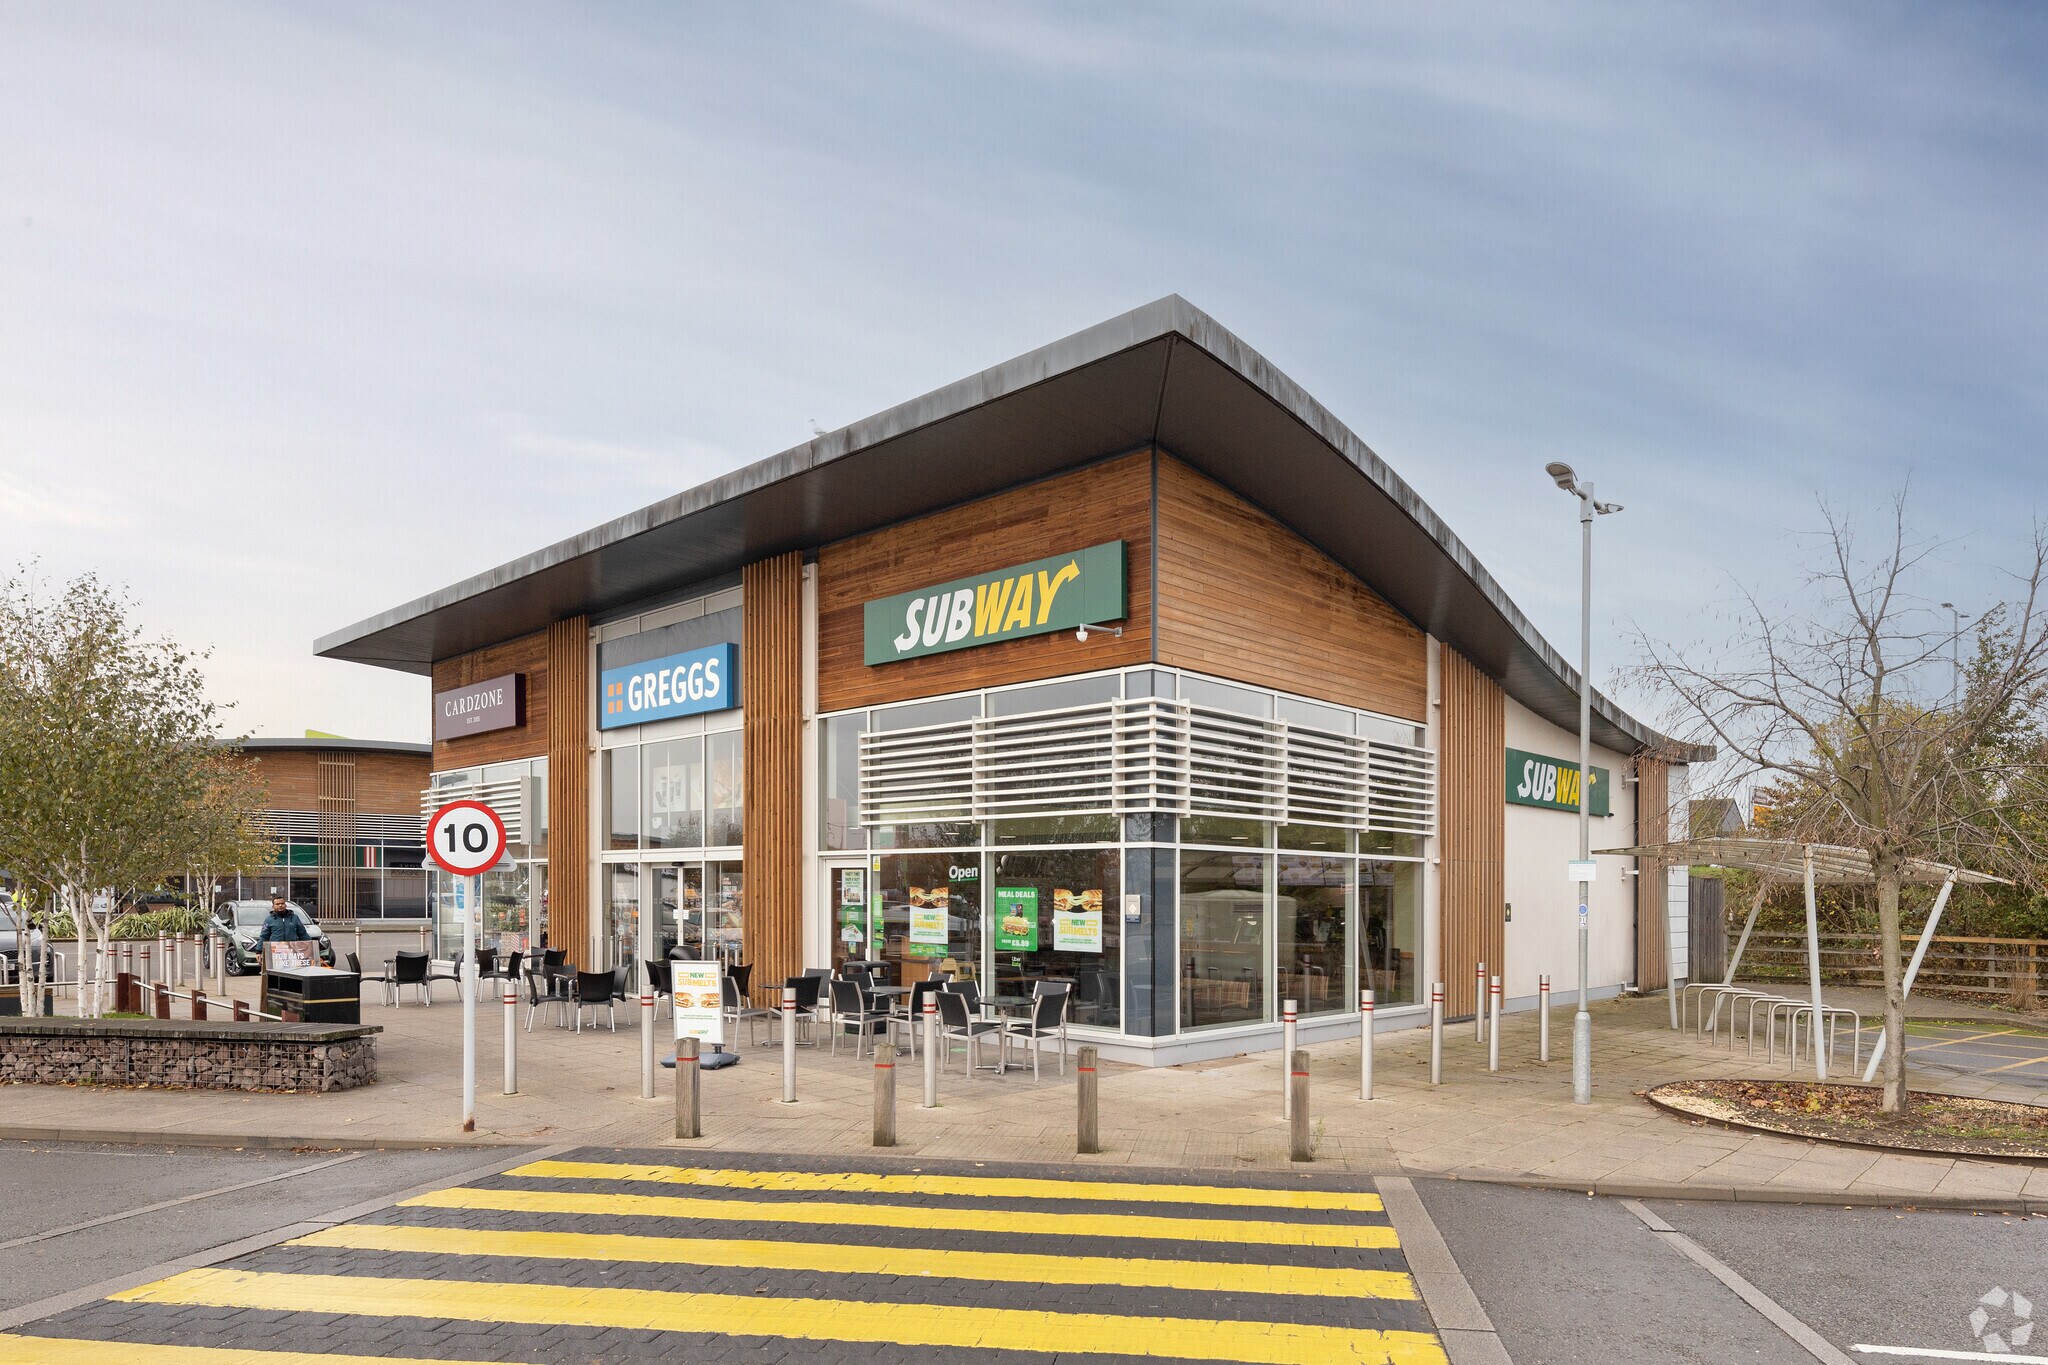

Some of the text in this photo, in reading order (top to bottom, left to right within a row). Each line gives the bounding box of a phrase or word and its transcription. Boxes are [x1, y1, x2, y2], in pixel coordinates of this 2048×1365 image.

[894, 559, 1080, 653] SUBWAY
[628, 658, 720, 711] GREGGS
[445, 688, 503, 717] CARDZONE
[1517, 759, 1596, 806] SUBWA
[444, 823, 488, 853] 10
[949, 865, 978, 881] Open
[1059, 926, 1097, 935] SUBMELTS
